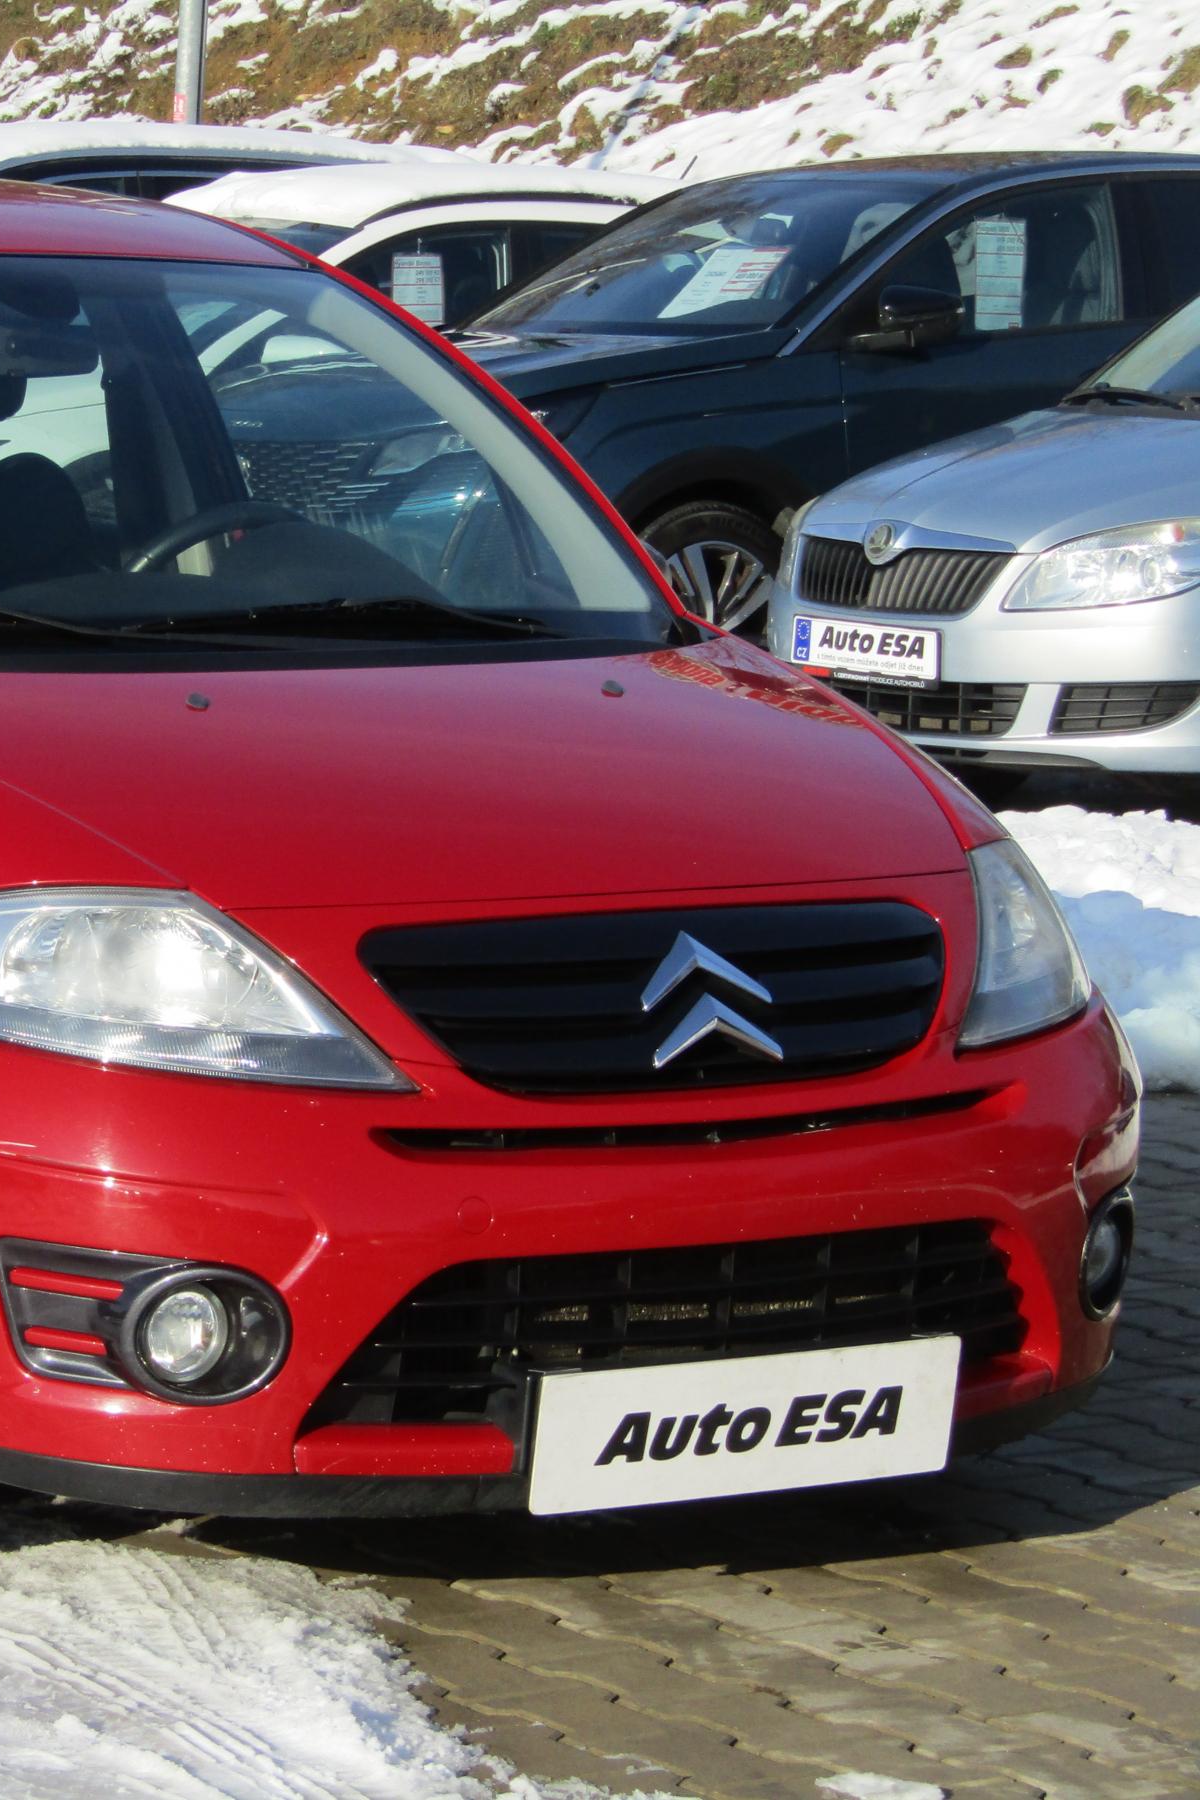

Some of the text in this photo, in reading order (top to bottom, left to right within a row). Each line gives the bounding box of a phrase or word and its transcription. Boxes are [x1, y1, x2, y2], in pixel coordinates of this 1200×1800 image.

[796, 646, 808, 659] CZ
[818, 625, 925, 660] Auto ESA
[880, 660, 897, 670] odjet
[907, 663, 924, 672] dnes
[594, 1385, 903, 1466] Auto ESA
